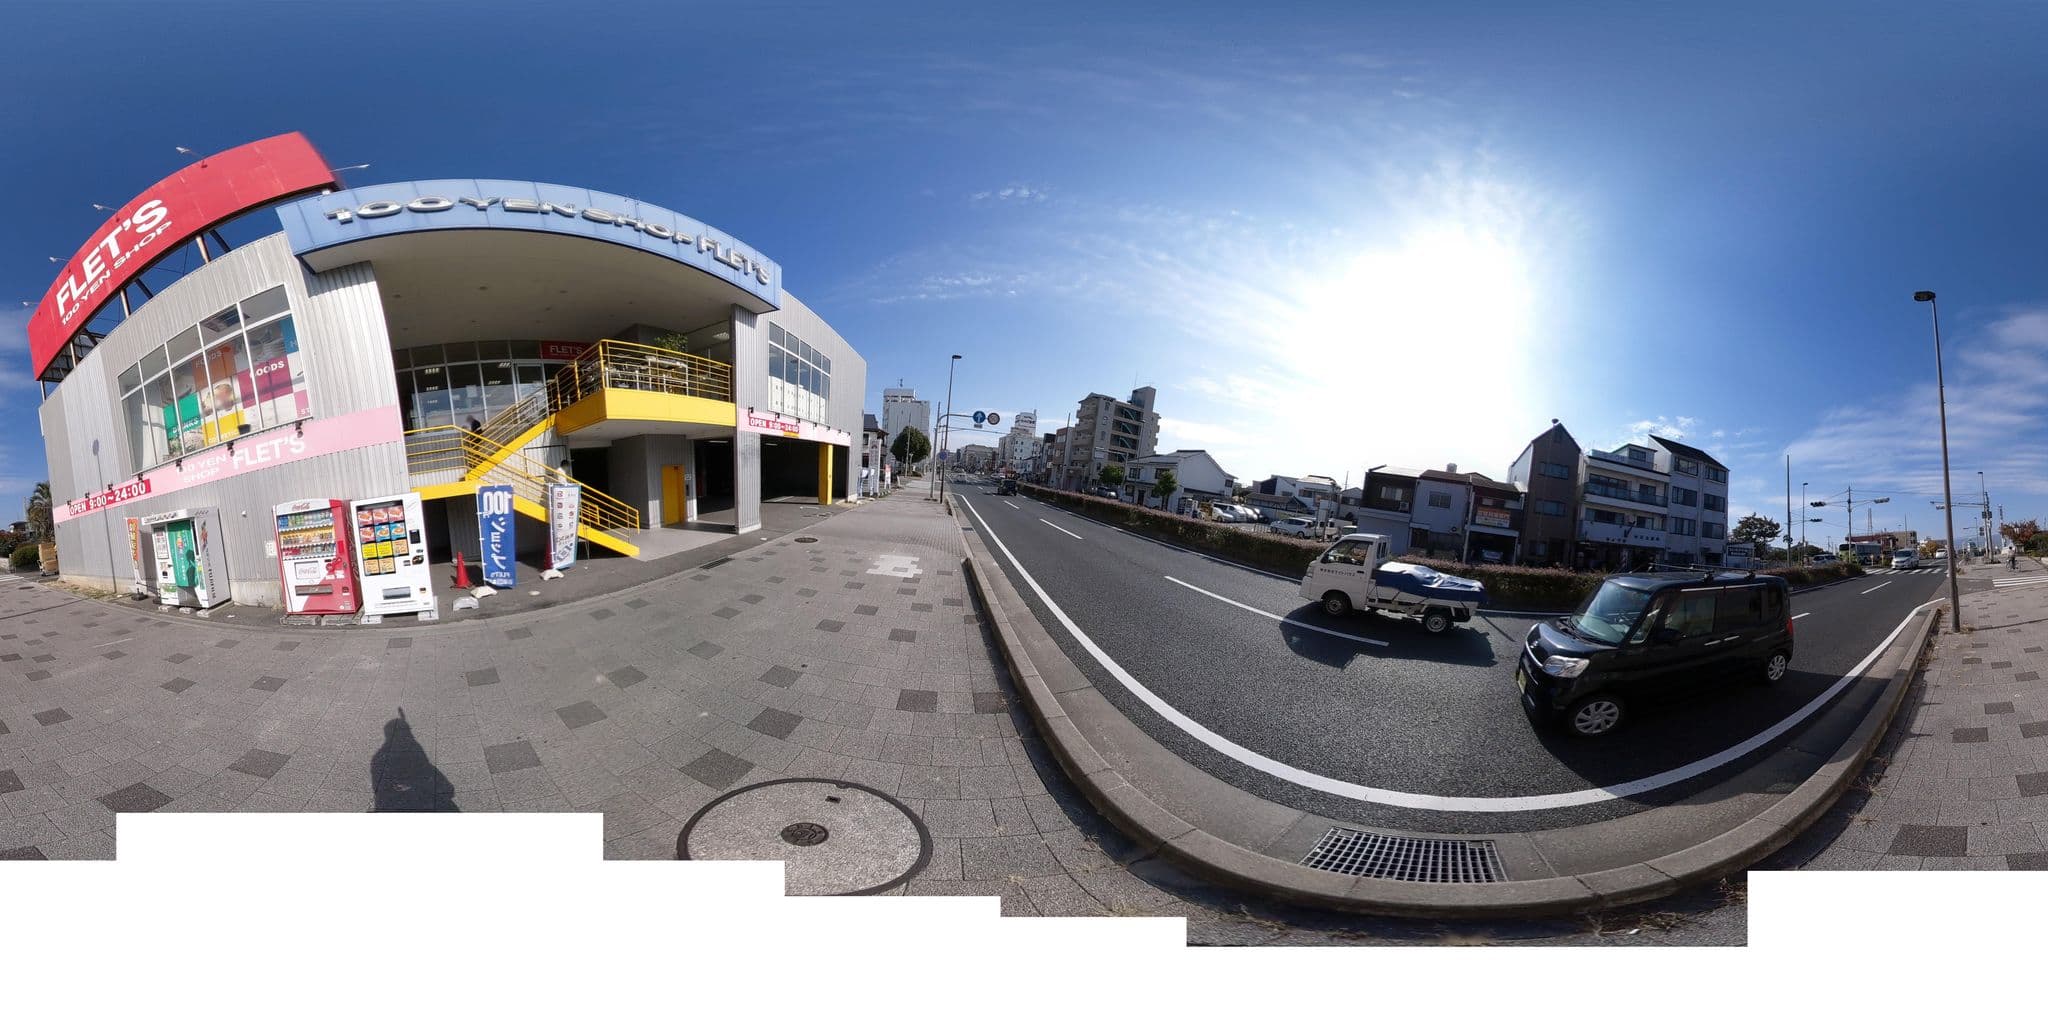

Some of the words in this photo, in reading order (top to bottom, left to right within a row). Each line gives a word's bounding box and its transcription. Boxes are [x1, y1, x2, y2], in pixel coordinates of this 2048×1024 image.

[324, 195, 455, 225] 100
[458, 194, 578, 219] YEN
[581, 207, 694, 245] SHOP
[696, 222, 771, 286] FLET'S
[56, 199, 168, 317] FLET'S
[61, 302, 80, 326] 100
[80, 269, 112, 302] YEN
[113, 220, 173, 270] SHOP
[248, 360, 285, 379] OODS
[750, 418, 765, 428] OPEN
[197, 454, 227, 470] YEN
[231, 436, 306, 470] FLET'S
[183, 467, 220, 483] SHOP
[69, 502, 87, 516] OPEN
